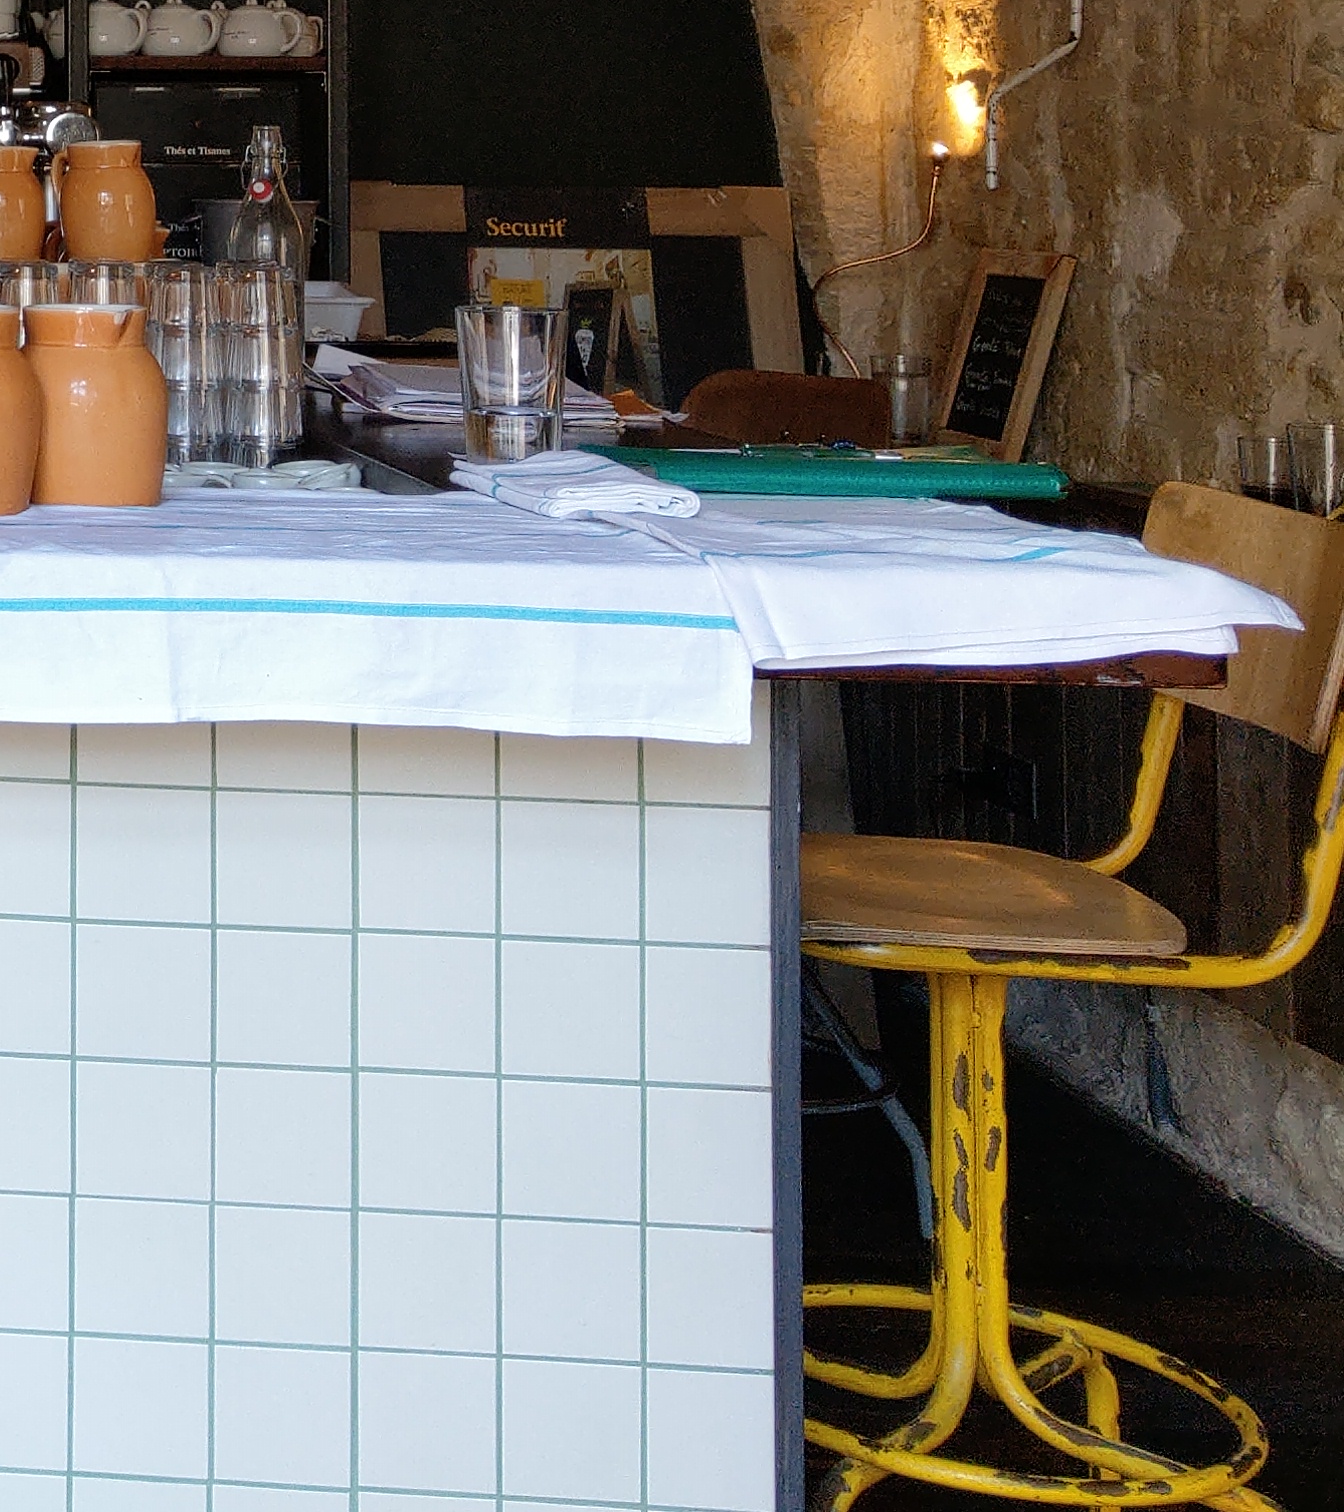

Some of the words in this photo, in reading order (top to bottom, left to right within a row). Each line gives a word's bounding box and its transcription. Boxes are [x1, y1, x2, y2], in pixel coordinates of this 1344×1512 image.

[163, 145, 186, 155] Thés
[187, 147, 196, 155] et
[197, 146, 231, 155] Tisanes
